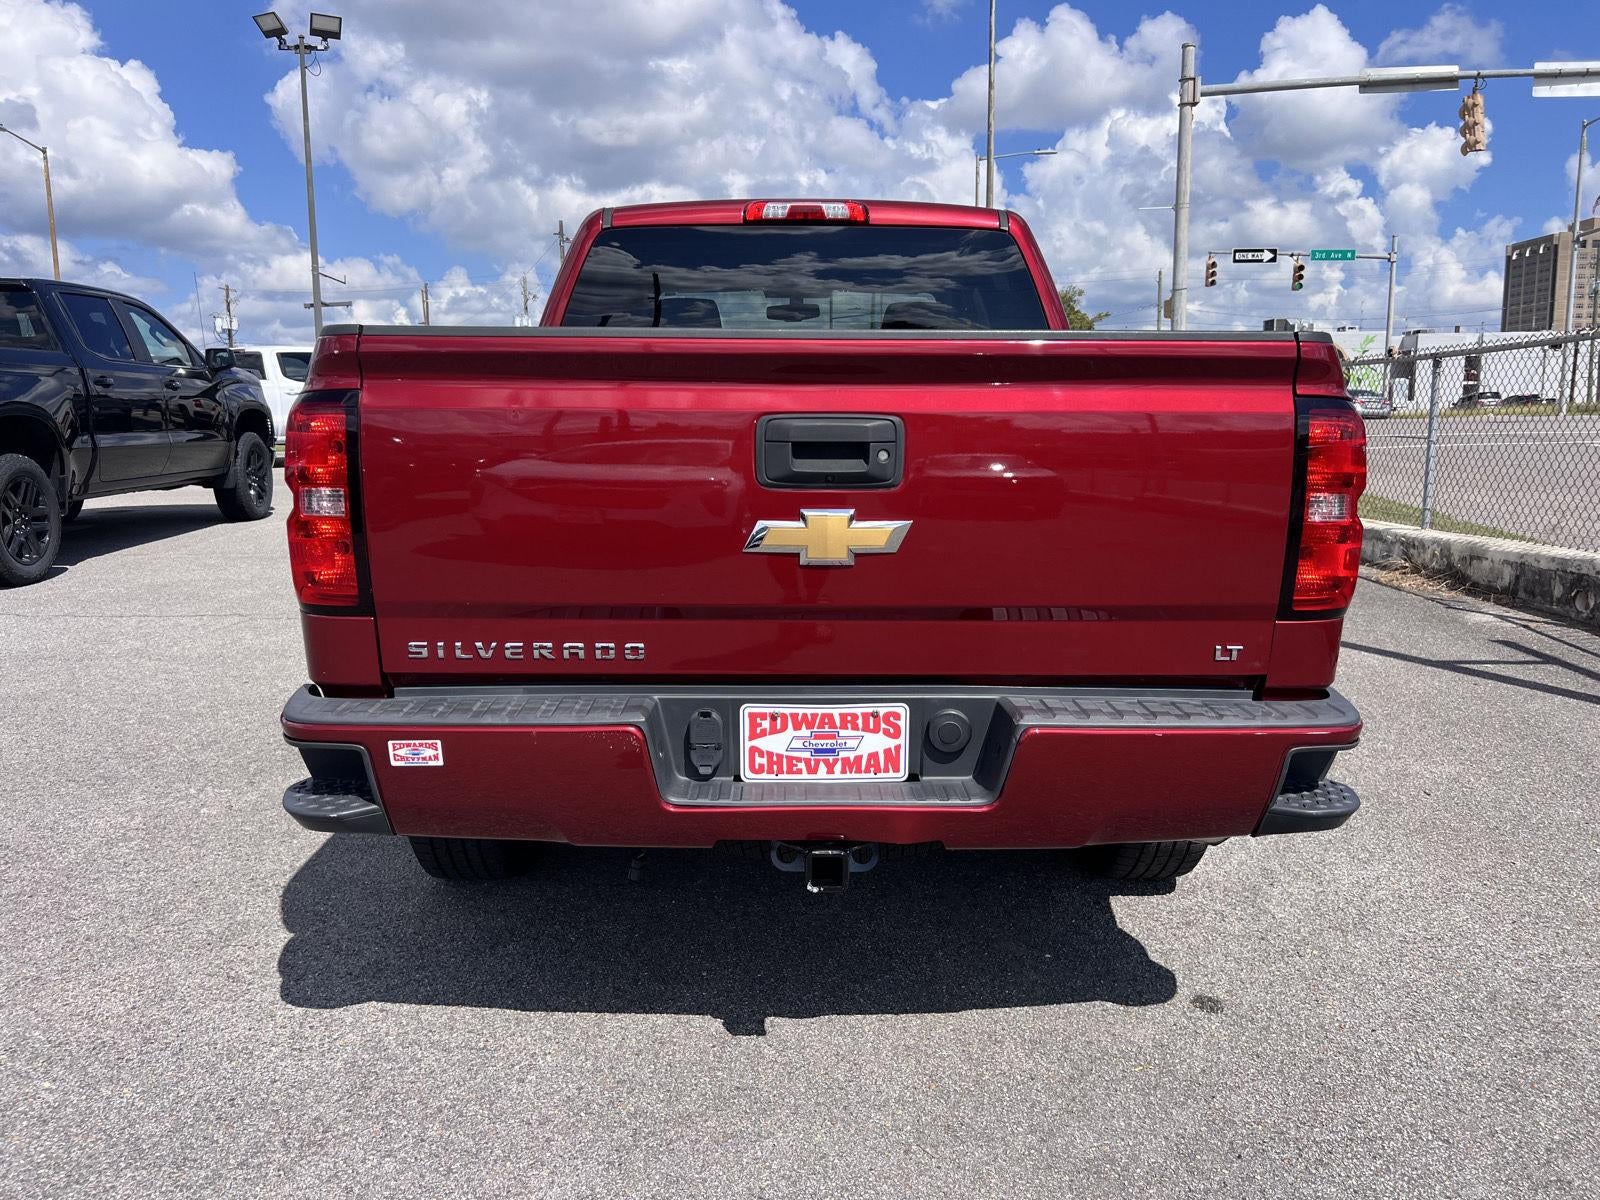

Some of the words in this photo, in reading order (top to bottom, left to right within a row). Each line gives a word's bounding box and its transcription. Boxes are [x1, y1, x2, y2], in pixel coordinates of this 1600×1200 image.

[407, 641, 646, 660] SILVERADO
[1215, 645, 1244, 661] LT
[748, 710, 902, 741] EDWARDS
[392, 742, 439, 751] EDWARDS
[802, 740, 848, 748] Chevrolet
[393, 753, 440, 762] CHEVYMAN
[748, 744, 902, 775] CHEVYMAN
